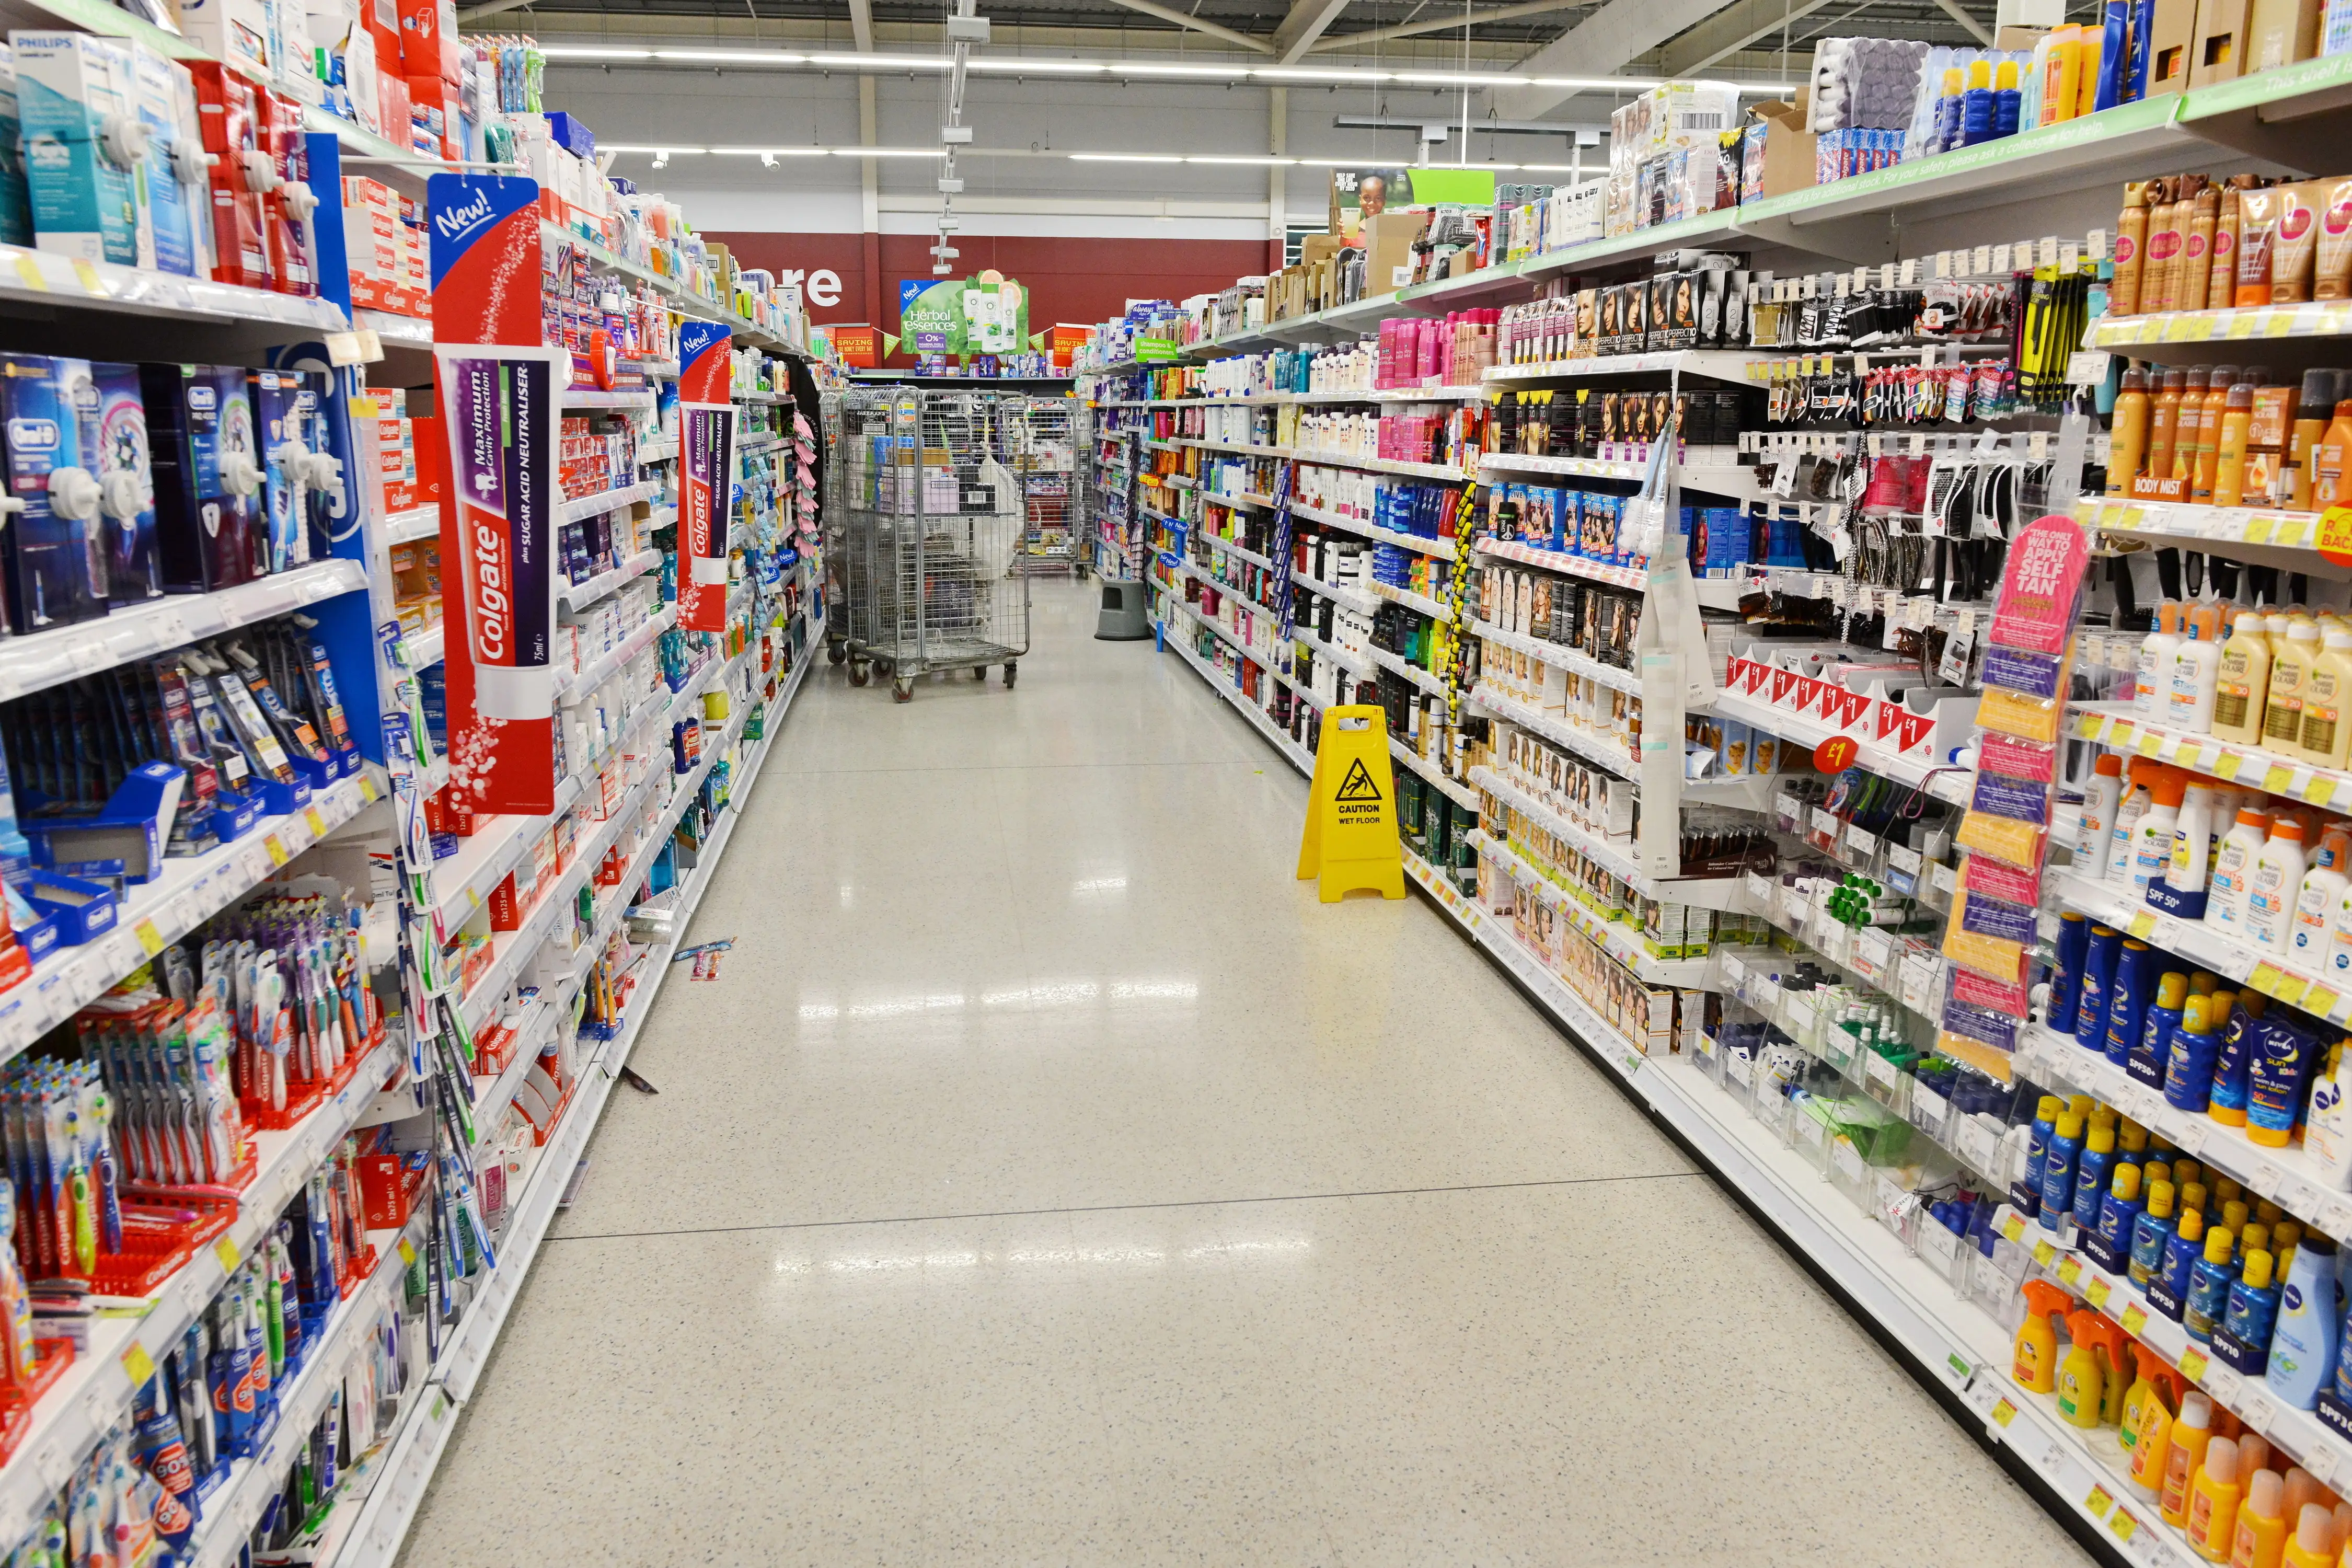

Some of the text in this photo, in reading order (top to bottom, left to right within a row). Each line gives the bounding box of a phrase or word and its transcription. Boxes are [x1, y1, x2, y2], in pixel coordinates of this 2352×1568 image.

[17, 38, 73, 48] PHILIPS
[2264, 74, 2295, 93] This
[2299, 60, 2341, 85] shelf
[1785, 196, 1802, 207] shelf
[1811, 191, 1820, 201] for
[1821, 181, 1859, 198] additional
[1859, 175, 1881, 190] stock.
[1883, 171, 1896, 184] For
[1899, 168, 1919, 181] your
[1919, 160, 1947, 176] safety
[1948, 153, 1978, 171] please
[1979, 148, 1996, 160] ask
[1998, 147, 2004, 155] a
[2006, 132, 2057, 154] colleague
[2058, 129, 2075, 141] for
[2078, 120, 2105, 138] help.
[367, 182, 387, 203] Colgate
[436, 187, 492, 237] New!
[373, 215, 393, 234] Colgate
[351, 283, 375, 299] Colgate
[384, 292, 406, 307] Colgate
[903, 283, 919, 300] New!
[910, 309, 951, 321] Herbal
[1133, 304, 1155, 315] always
[1706, 309, 1712, 319] 2
[1730, 309, 1736, 319] 2
[1846, 302, 1859, 310] mia
[904, 319, 957, 331] essences
[684, 329, 710, 352] New!
[925, 334, 939, 342] 0%
[1906, 373, 1926, 385] mia rose
[471, 371, 487, 466] Maximum
[483, 372, 494, 467] Cavity Protection
[517, 366, 529, 468] NEUTRALISER
[521, 472, 531, 501] ACID
[1491, 488, 1503, 497] LIVE
[1511, 490, 1523, 499] LIVE
[2134, 478, 2182, 496] BODY MIST
[1531, 495, 1541, 505] LIVE
[1567, 498, 1576, 508] LIVE
[1604, 504, 1614, 514] LIVE
[521, 504, 531, 546] SUGAR
[694, 489, 708, 555] Colgate
[1175, 522, 1189, 532] New!
[2028, 537, 2071, 551] WAY TO
[2048, 531, 2073, 542] ONLY
[2321, 534, 2352, 549] BAC
[780, 550, 794, 560] New!
[1166, 557, 1178, 566] New!
[2023, 546, 2068, 563] APPLY
[2018, 558, 2065, 578] SELF
[477, 525, 508, 660] Colgate
[534, 642, 544, 661] 75ml
[1729, 660, 1737, 679] £1
[1751, 665, 1760, 687] £1
[1777, 673, 1785, 695] £1
[1801, 681, 1810, 702] £1
[2237, 686, 2248, 696] 30
[1827, 688, 1837, 710] £1
[1846, 696, 1856, 720] £1
[2289, 698, 2301, 709] 20
[1883, 705, 1893, 731] £1
[2326, 710, 2336, 720] 10
[1905, 719, 1917, 743] £1
[1828, 742, 1846, 767] £1
[1338, 804, 1380, 814] CAUTION
[1823, 790, 1836, 809] Colgate
[501, 888, 508, 897] ml
[2148, 887, 2180, 908] SPF 50+
[1644, 927, 1660, 942] NUTRISSE
[471, 959, 488, 982] Colgate
[1852, 957, 1871, 971] Colgate
[486, 1028, 508, 1051] Colgate
[2268, 1040, 2292, 1051] NIVEA
[2129, 1058, 2156, 1078] SPF50+
[2266, 1057, 2287, 1067] sun
[2254, 1077, 2269, 1086] swim
[2276, 1081, 2292, 1092] play
[2268, 1085, 2288, 1096] lotion
[291, 1094, 319, 1119] Colgate
[2049, 1154, 2066, 1167] NIVEA
[2079, 1170, 2095, 1182] NIVEA
[487, 1169, 497, 1204] protect
[387, 1188, 397, 1221] 12x75 ml
[57, 1208, 71, 1265] Colgate
[191, 1215, 229, 1244] Colgate
[457, 1212, 468, 1248] protect
[353, 1223, 364, 1260] Colgate
[2086, 1239, 2111, 1262] SPF50+
[146, 1251, 186, 1286] Colgate
[2149, 1287, 2175, 1310] SPF50
[2285, 1291, 2301, 1306] NIVEA
[2213, 1335, 2240, 1359] SPF10
[159, 1503, 179, 1525] 90
